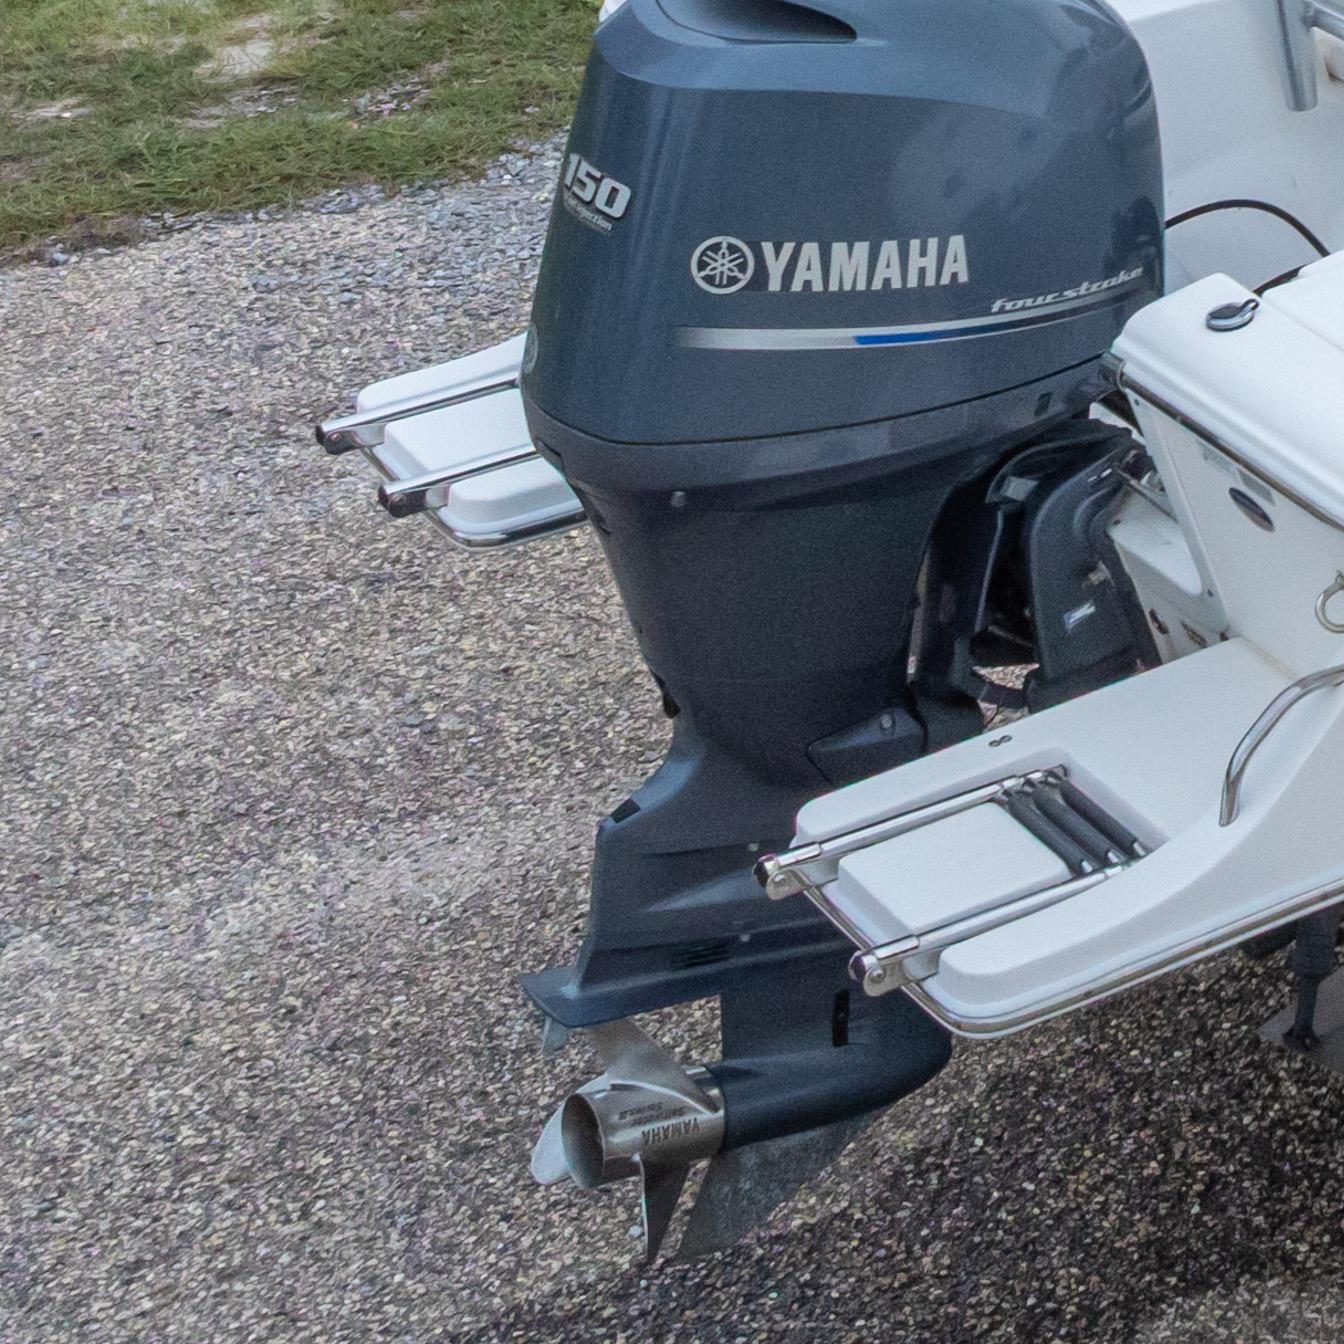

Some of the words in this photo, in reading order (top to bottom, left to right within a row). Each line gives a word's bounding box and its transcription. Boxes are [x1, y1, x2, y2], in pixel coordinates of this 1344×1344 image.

[564, 153, 631, 218] 150
[761, 234, 969, 292] YAMAHA
[1059, 266, 1144, 300] stroke
[641, 1116, 699, 1146] YAMAHA
